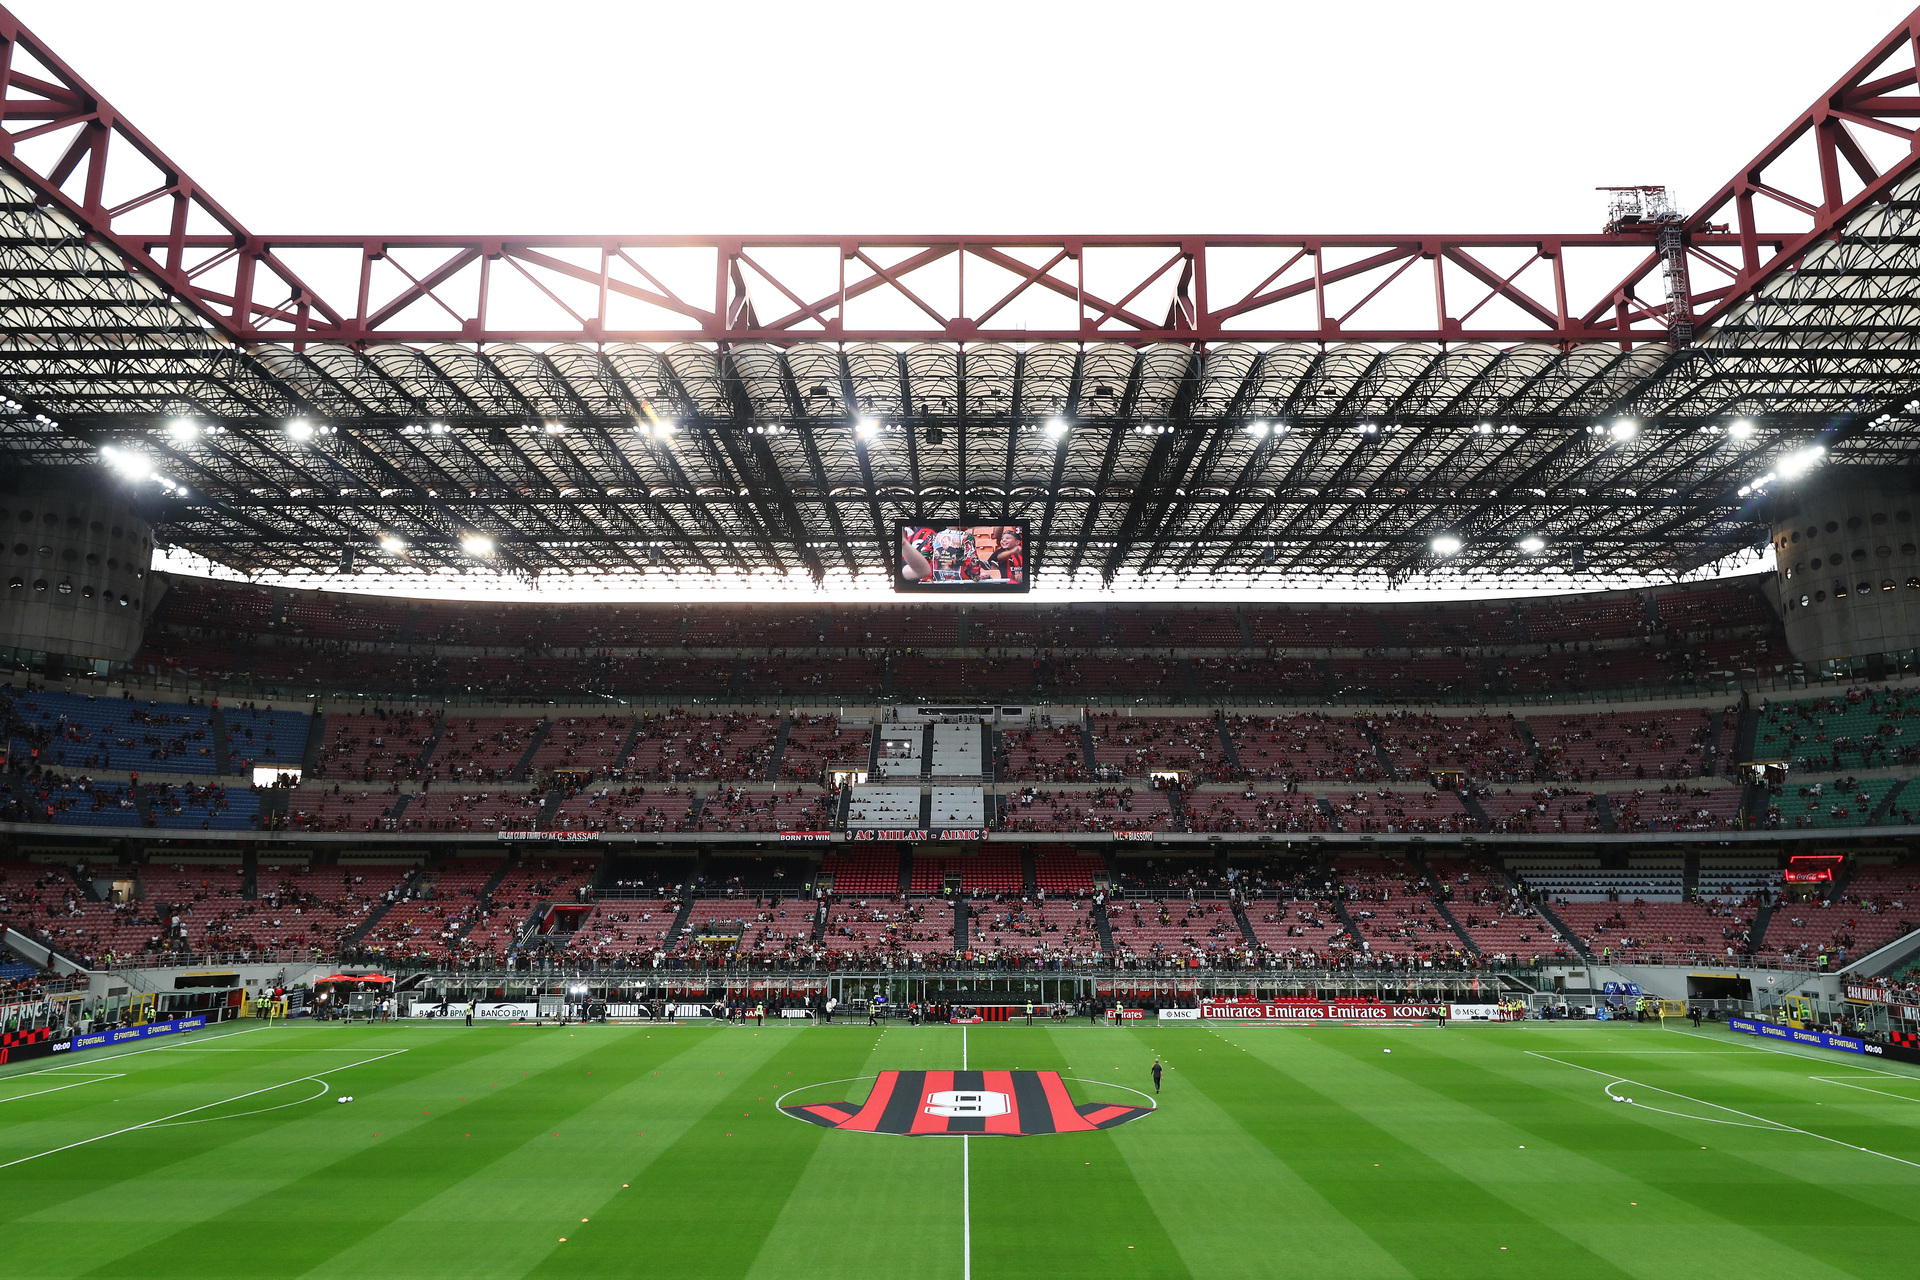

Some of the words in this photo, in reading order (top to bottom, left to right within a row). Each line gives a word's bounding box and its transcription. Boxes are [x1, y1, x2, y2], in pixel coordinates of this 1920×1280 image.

[567, 832, 599, 840] SASSARI
[854, 830, 874, 841] AC
[877, 829, 928, 841] MILAN
[940, 829, 980, 841] AIMC
[1847, 985, 1861, 999] CASA
[481, 1009, 510, 1017] BANCO
[512, 1009, 529, 1017] BPM
[604, 1004, 639, 1017] PUMA
[781, 1009, 806, 1018] PUMA
[1203, 1005, 1262, 1018] Emirates
[1265, 1005, 1324, 1018] Emirates
[1328, 1005, 1387, 1018] Emirates
[52, 1041, 71, 1052] 00:00
[1864, 1044, 1883, 1055] 00:00
